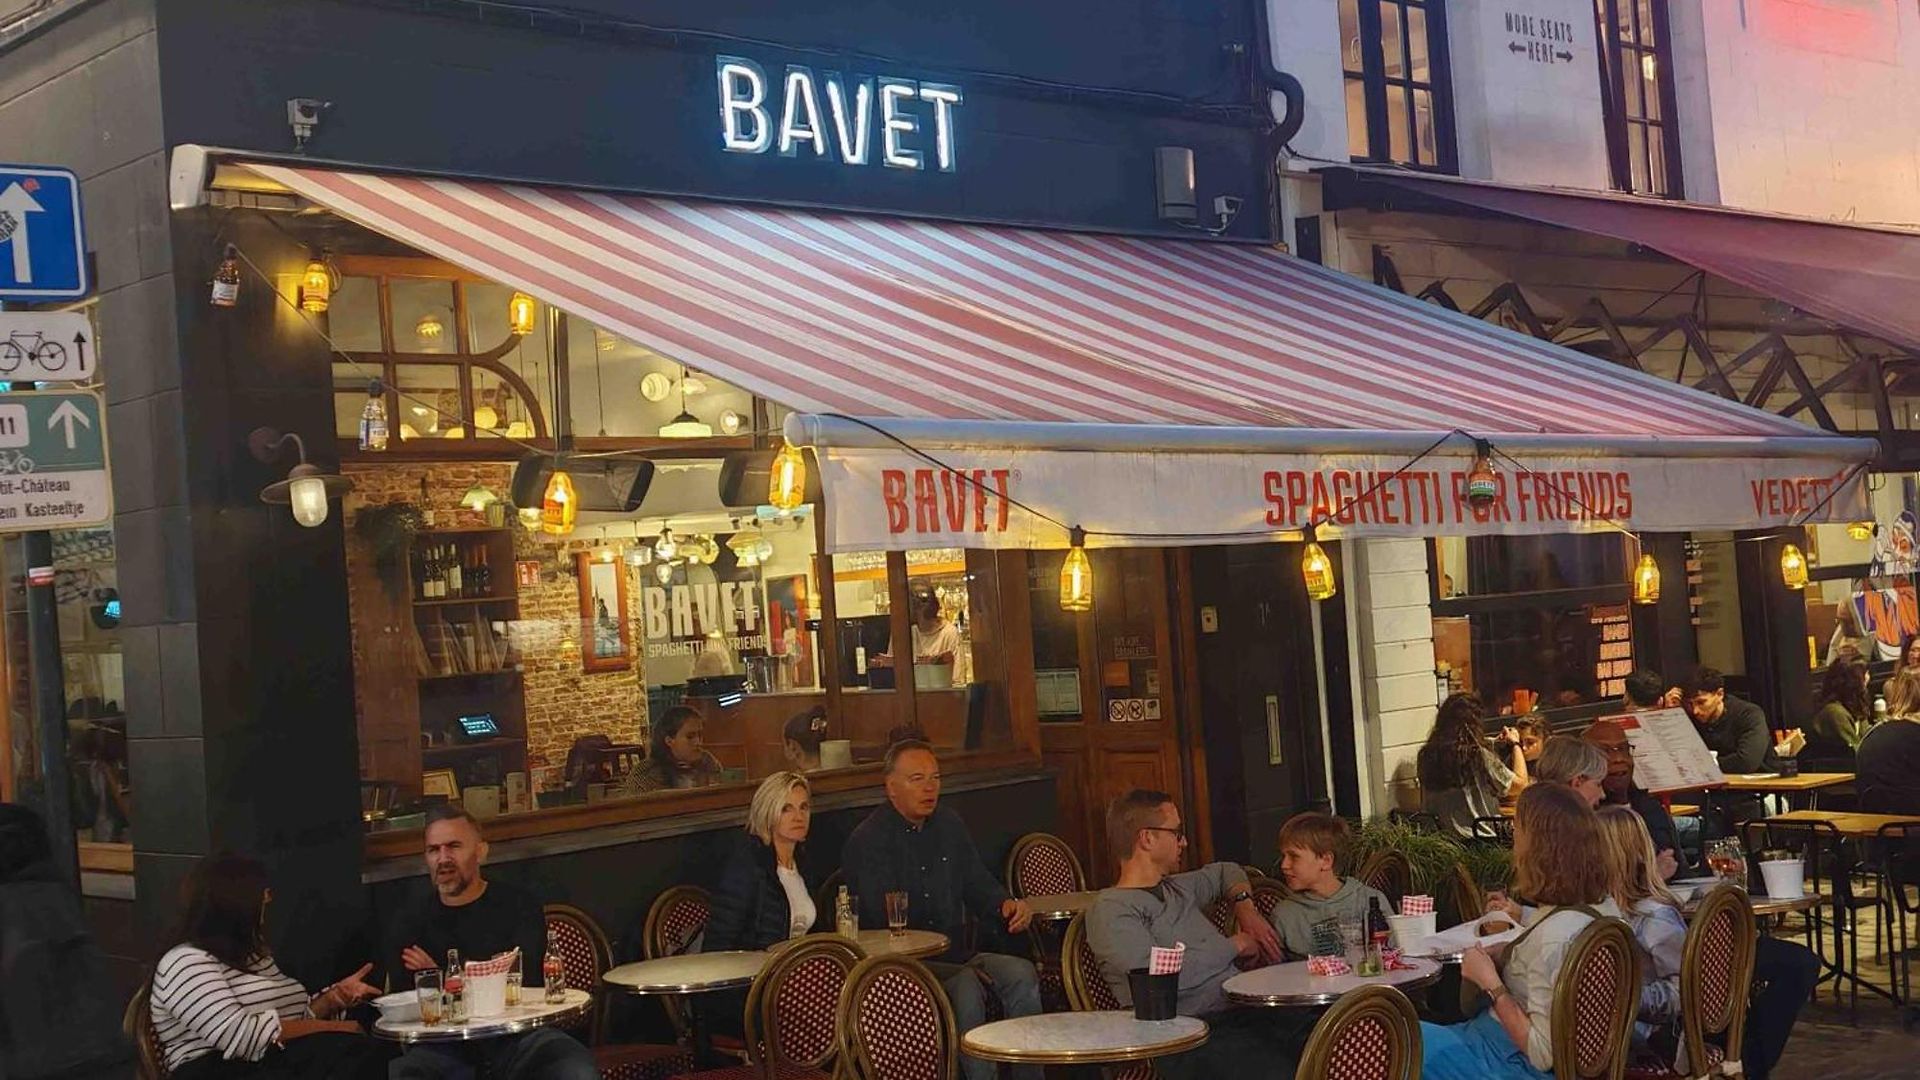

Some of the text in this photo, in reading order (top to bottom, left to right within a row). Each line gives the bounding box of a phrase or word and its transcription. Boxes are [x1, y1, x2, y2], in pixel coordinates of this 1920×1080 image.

[1505, 12, 1573, 43] MORE SEATS
[1527, 41, 1554, 64] HERE
[716, 54, 963, 173] BAVET
[1263, 470, 1443, 526] SPAGHETTI
[1516, 471, 1633, 523] FRIENDS
[644, 581, 757, 639] BAVET
[648, 640, 704, 658] SPAGHETTI
